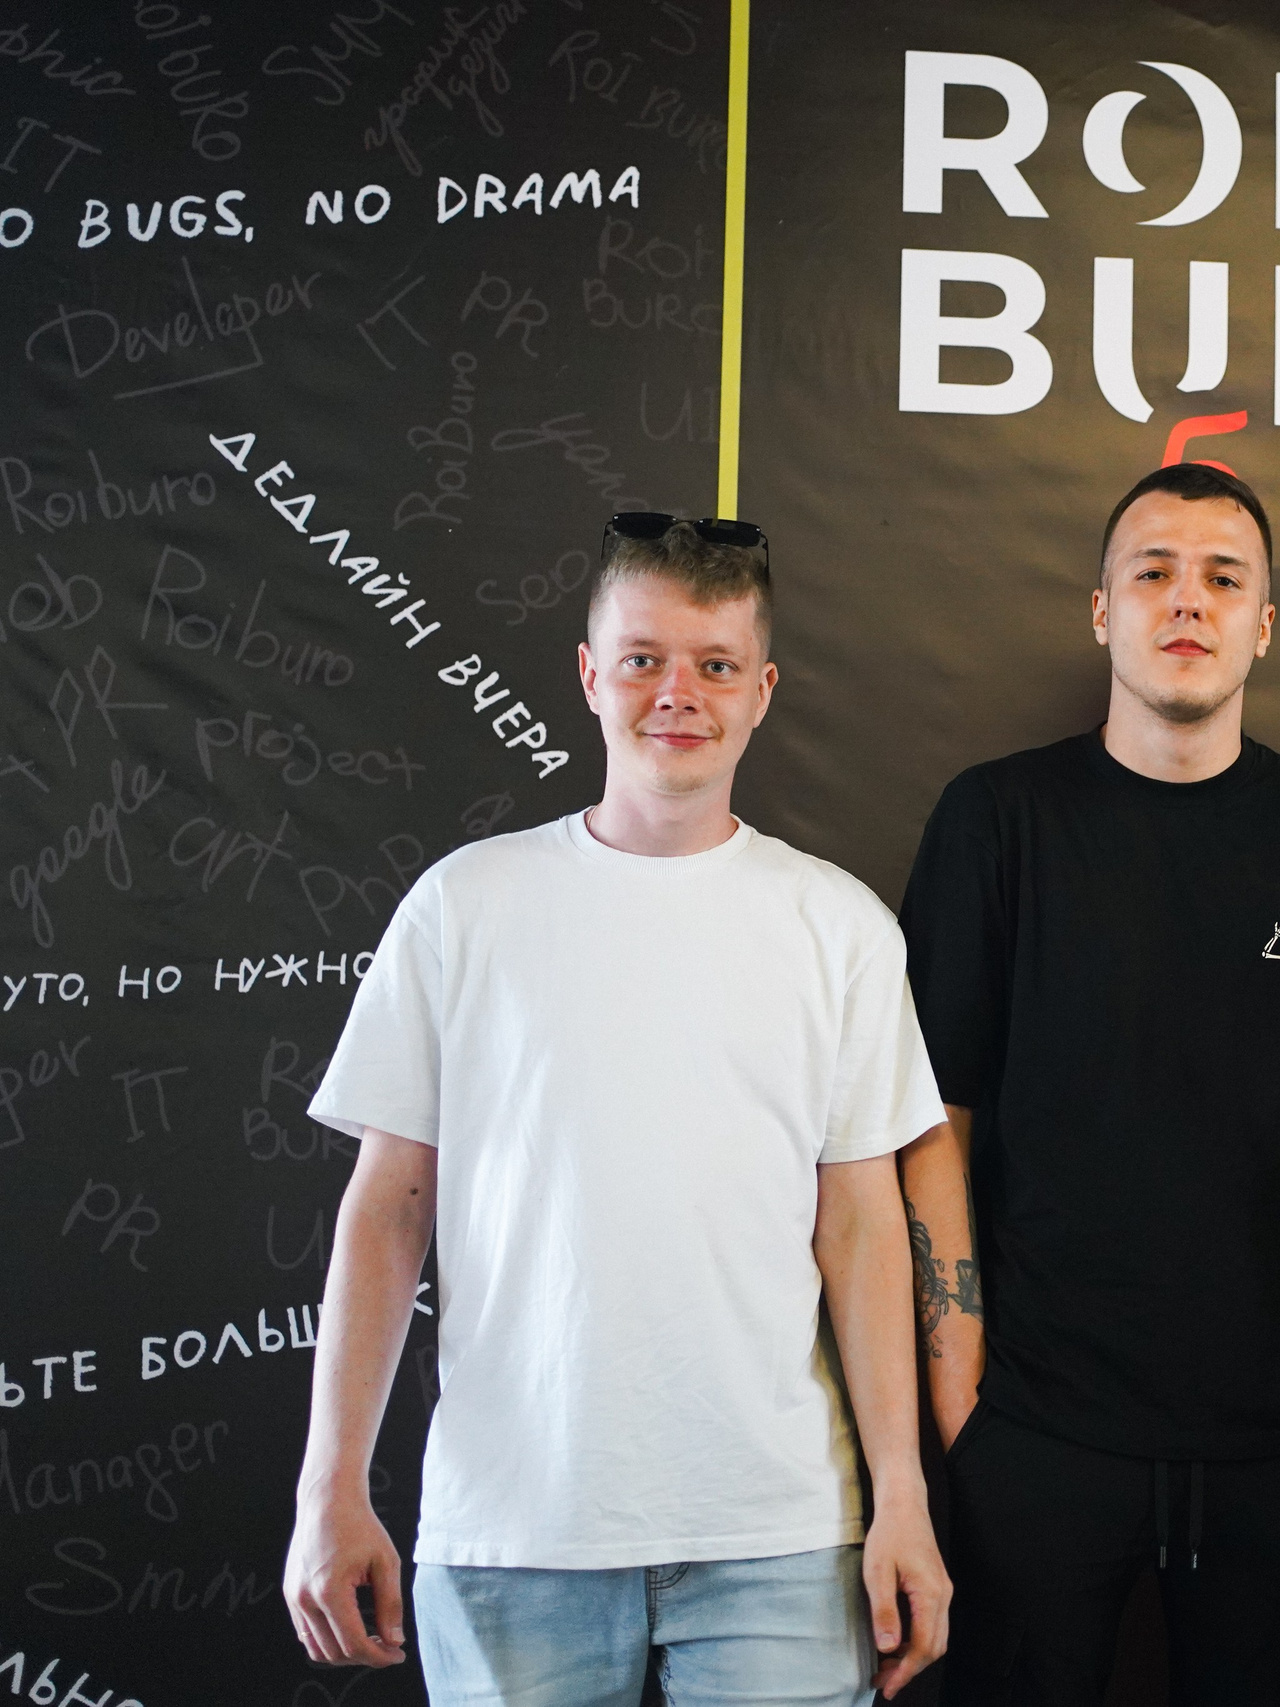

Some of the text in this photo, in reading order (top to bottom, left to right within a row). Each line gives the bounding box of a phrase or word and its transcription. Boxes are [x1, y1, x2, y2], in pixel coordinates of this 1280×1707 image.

[77, 188, 255, 250] BUGS,
[304, 183, 392, 226] NO
[436, 165, 641, 225] DRAMA
[208, 432, 570, 780] ДЕДЛАЙН ВЧЕРА
[117, 963, 184, 1000] НО
[140, 1302, 324, 1381] БОЛЬШ
